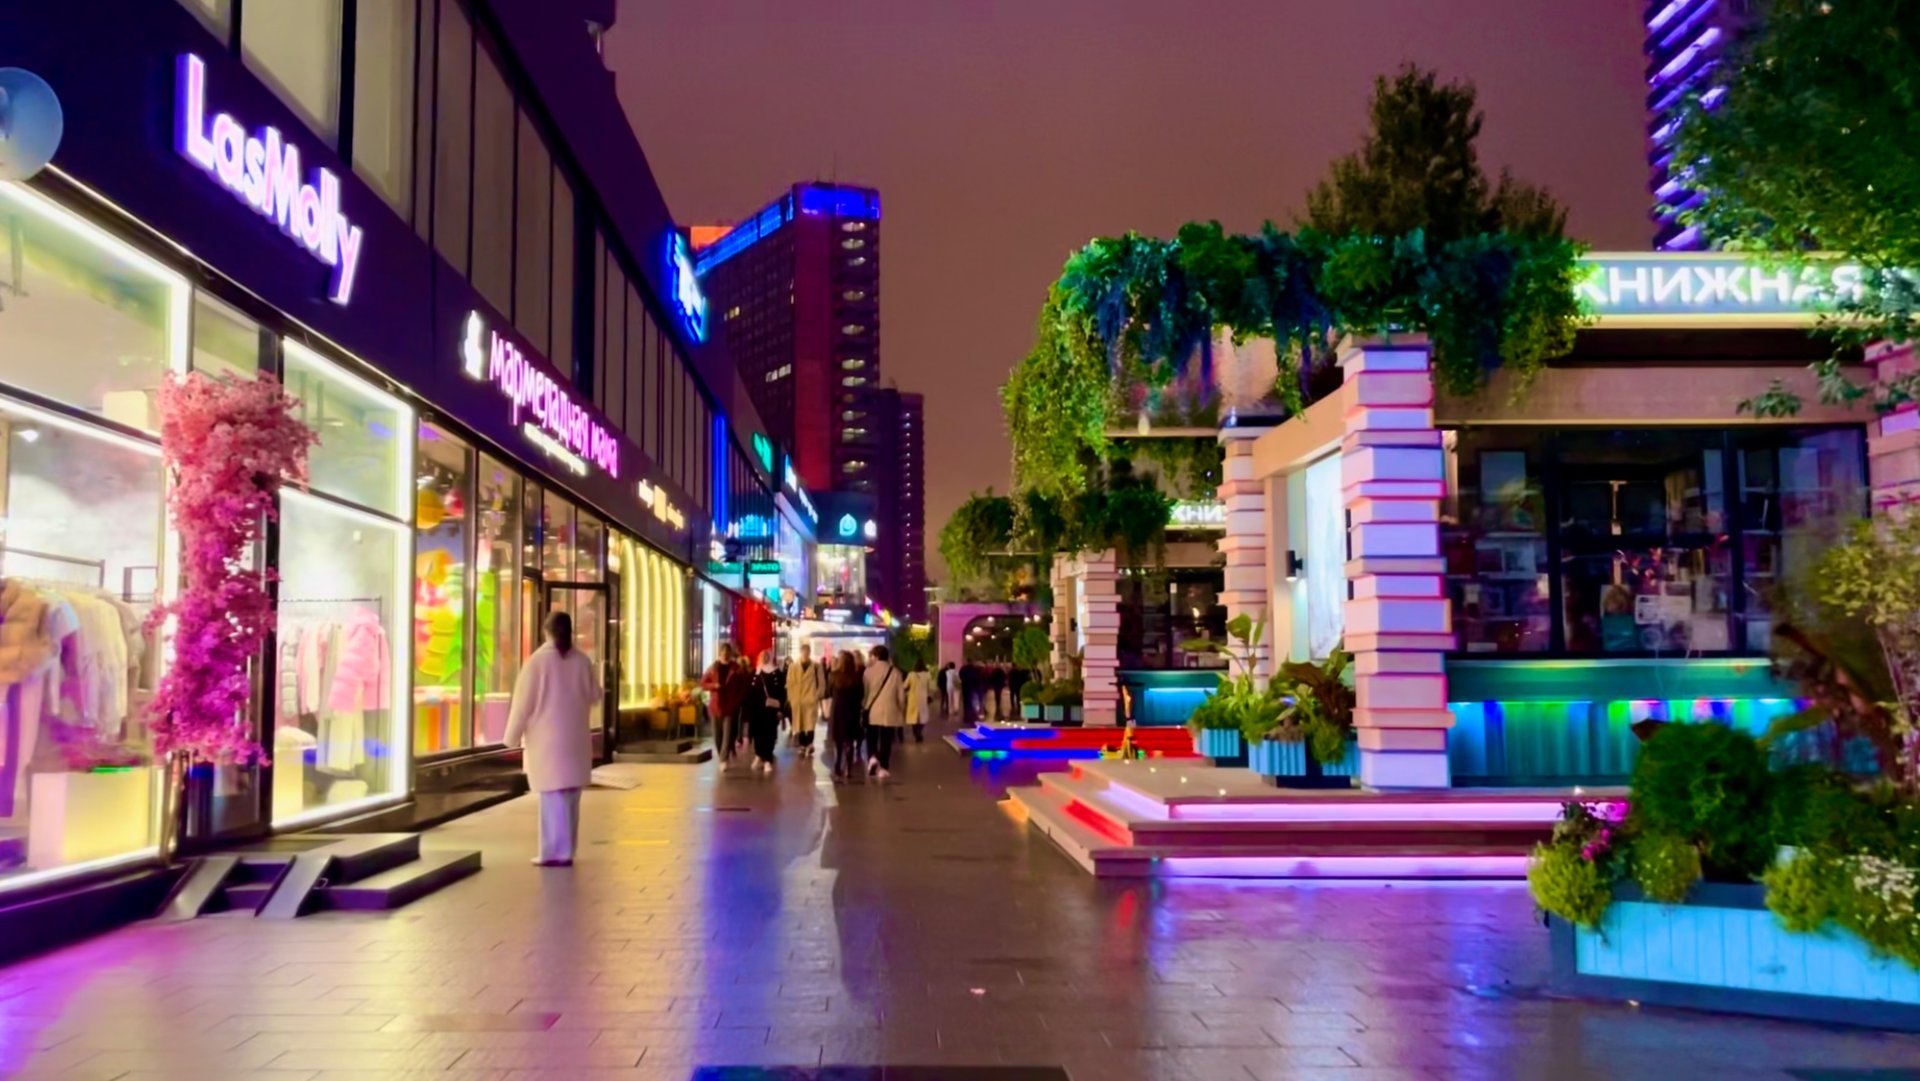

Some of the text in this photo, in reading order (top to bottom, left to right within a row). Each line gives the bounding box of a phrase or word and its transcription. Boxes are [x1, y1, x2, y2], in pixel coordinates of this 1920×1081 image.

[181, 52, 363, 306] LasMolly
[1573, 265, 1862, 304] КНИЖНАЯ
[590, 421, 618, 479] мама
[1169, 504, 1228, 522] КНИ
